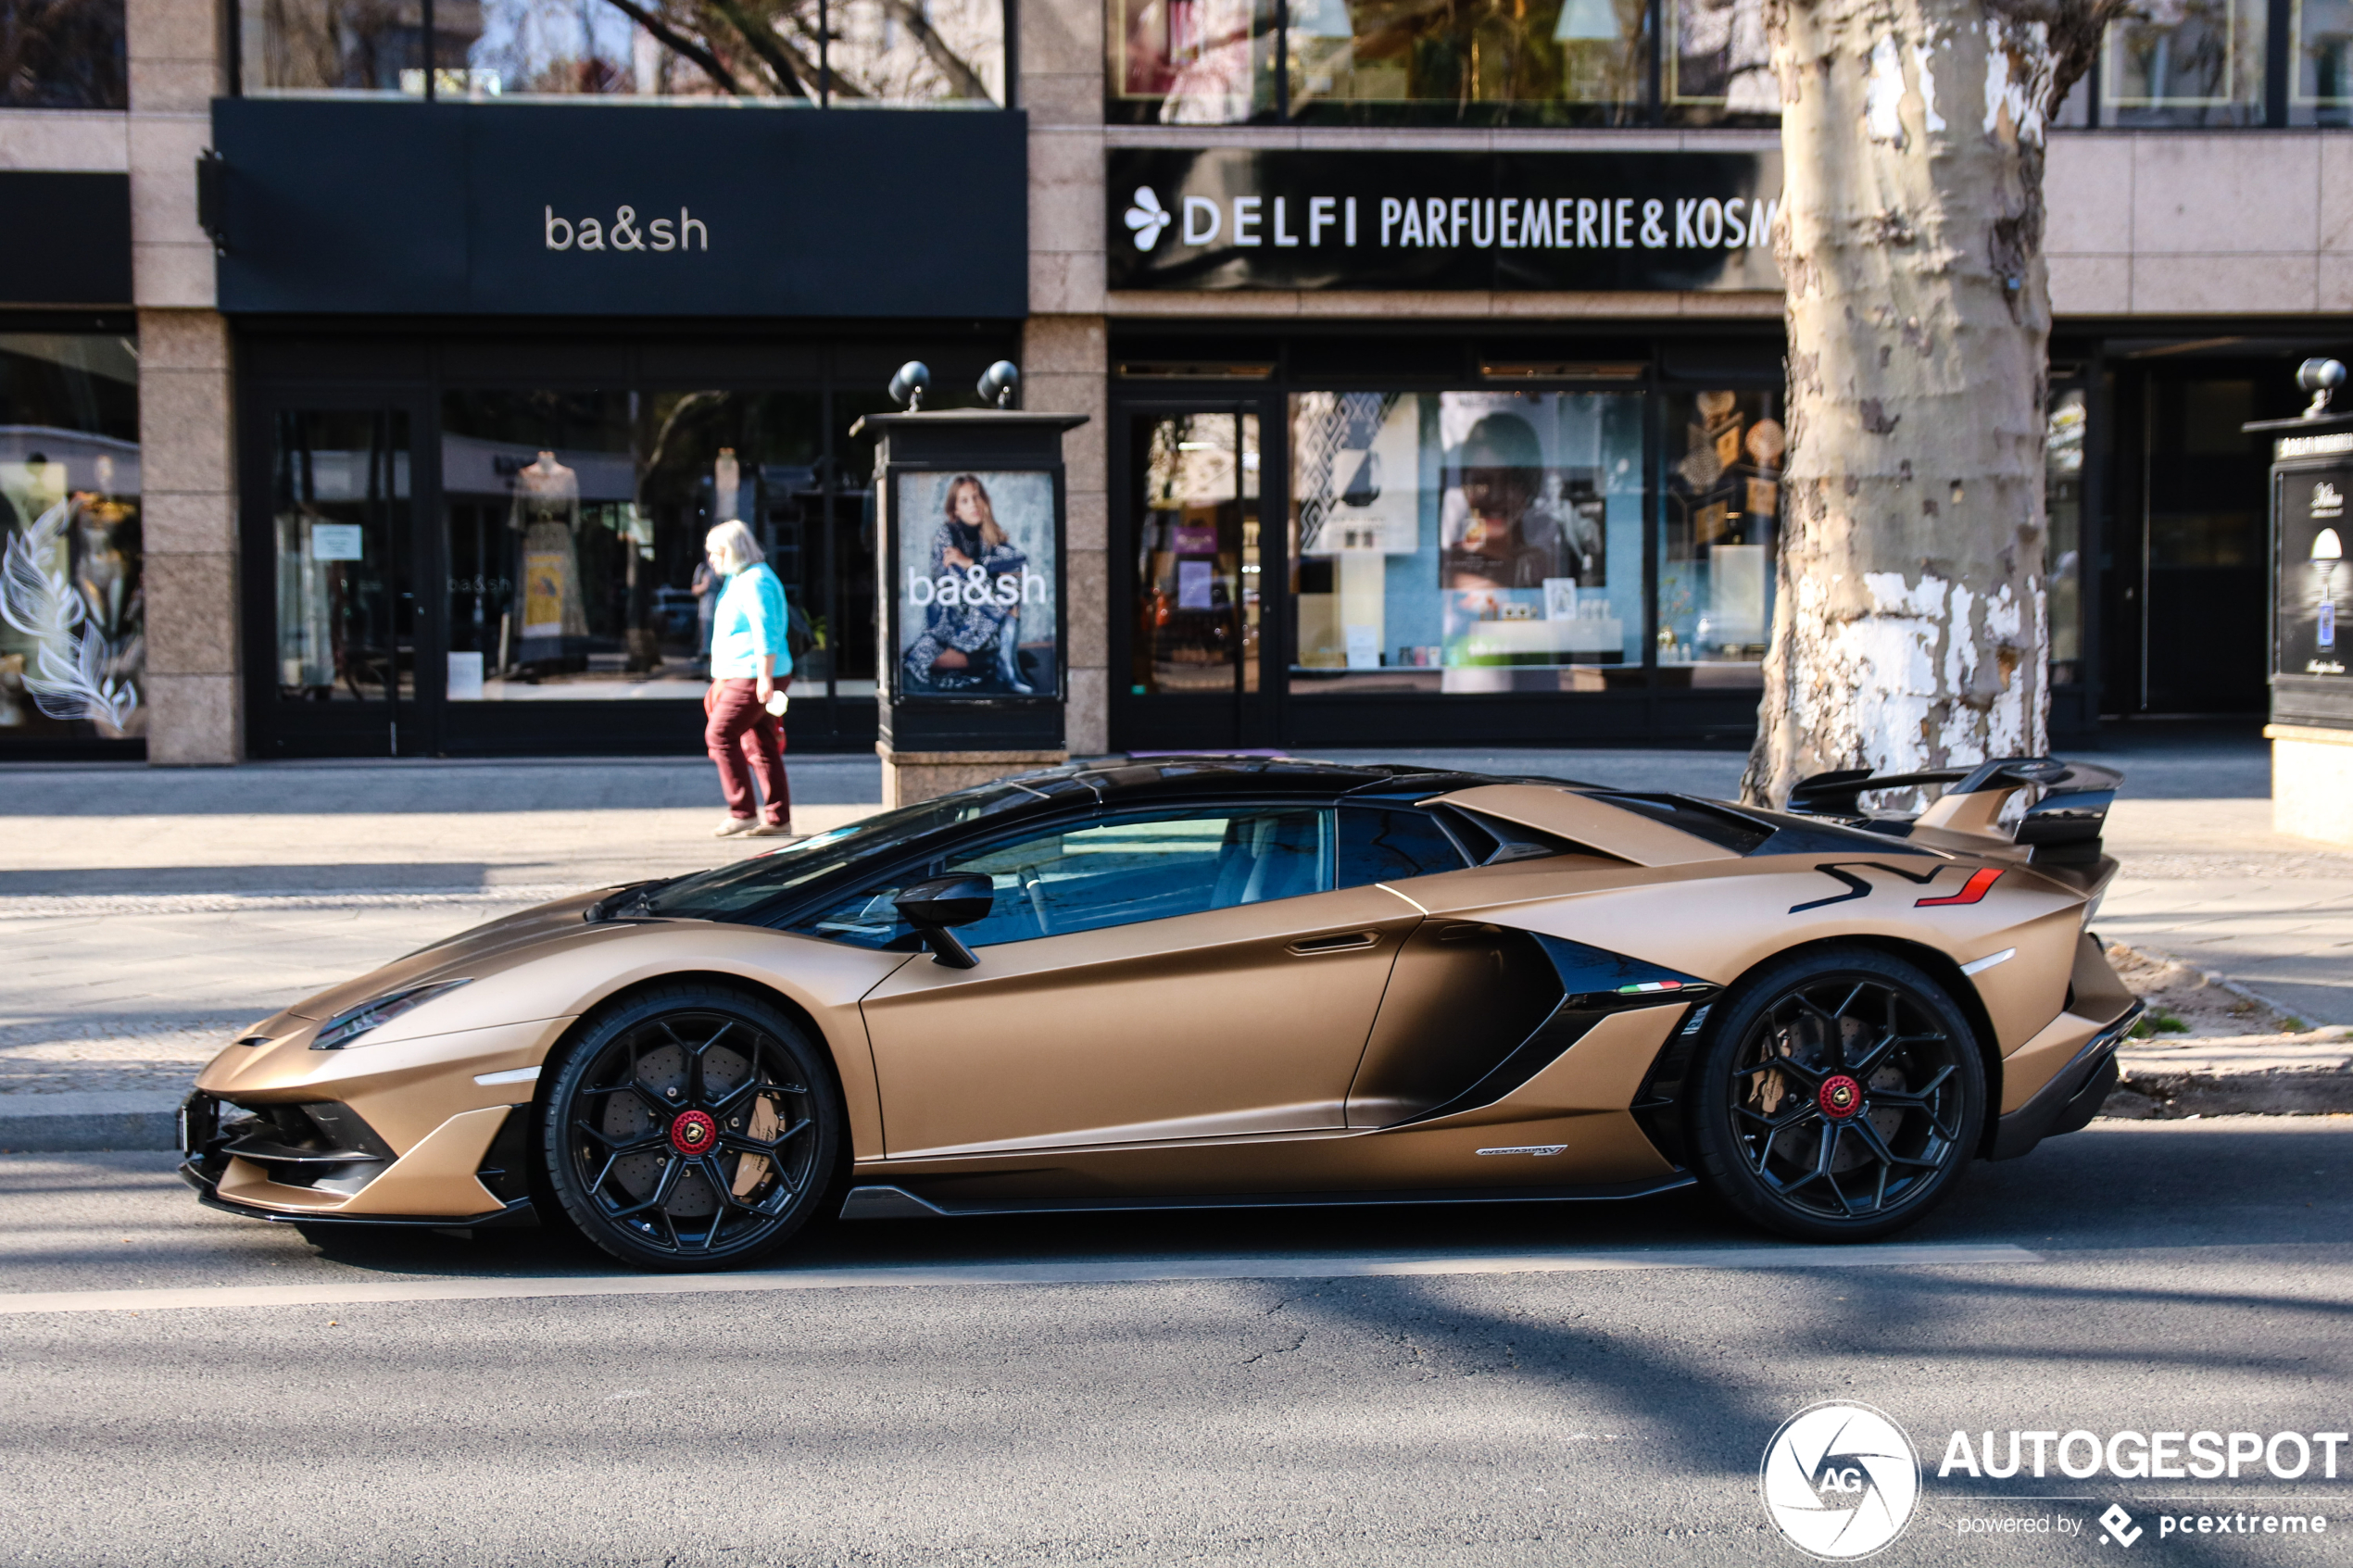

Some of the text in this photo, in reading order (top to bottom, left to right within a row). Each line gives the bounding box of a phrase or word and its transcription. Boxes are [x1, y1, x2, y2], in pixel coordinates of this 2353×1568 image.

[545, 204, 708, 252] ba&sh
[1183, 195, 1356, 247] DELFI
[908, 563, 1047, 607] ba&sh
